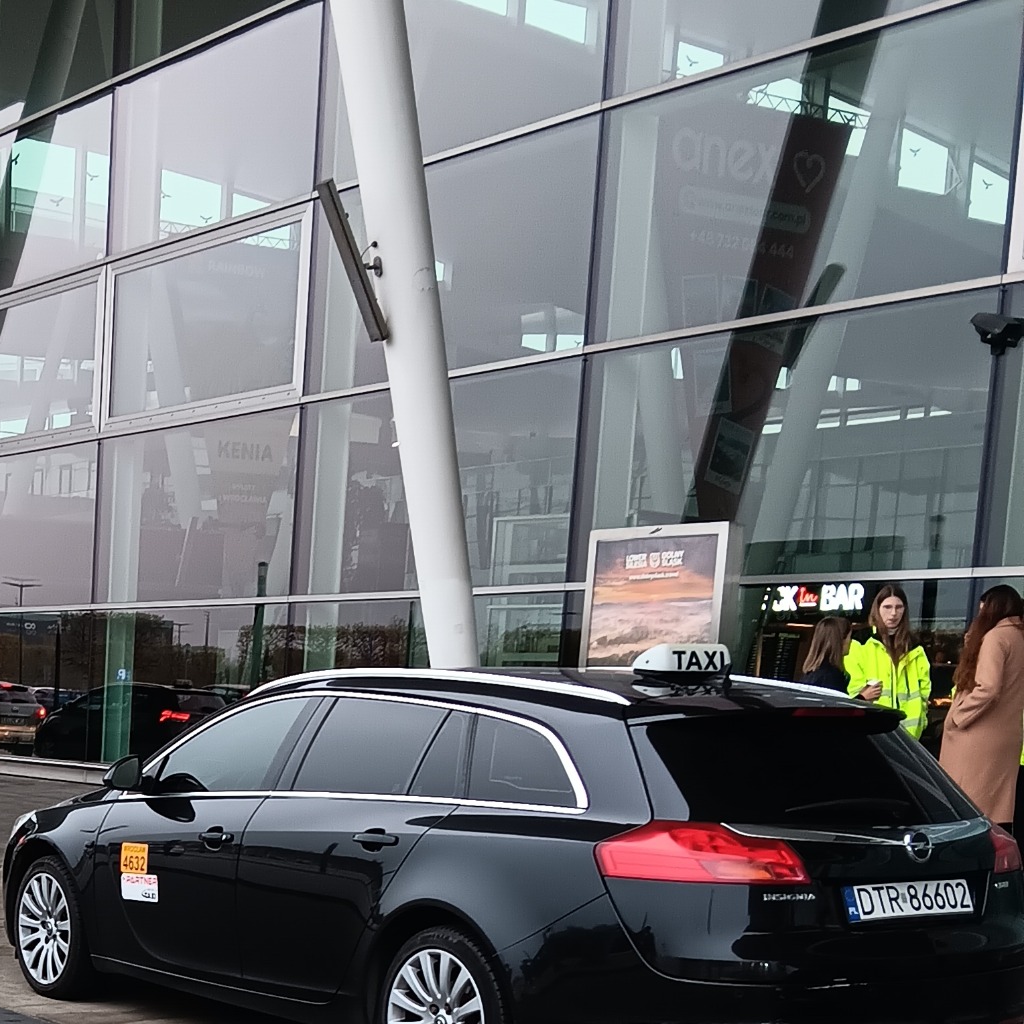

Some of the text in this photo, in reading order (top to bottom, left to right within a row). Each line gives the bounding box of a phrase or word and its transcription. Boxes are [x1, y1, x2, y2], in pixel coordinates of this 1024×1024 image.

[672, 126, 779, 184] anex
[217, 440, 272, 462] KENIA
[820, 583, 865, 611] BAR
[672, 650, 725, 670] TAXI
[123, 856, 146, 871] 4632
[857, 881, 971, 916] DTR 86602
